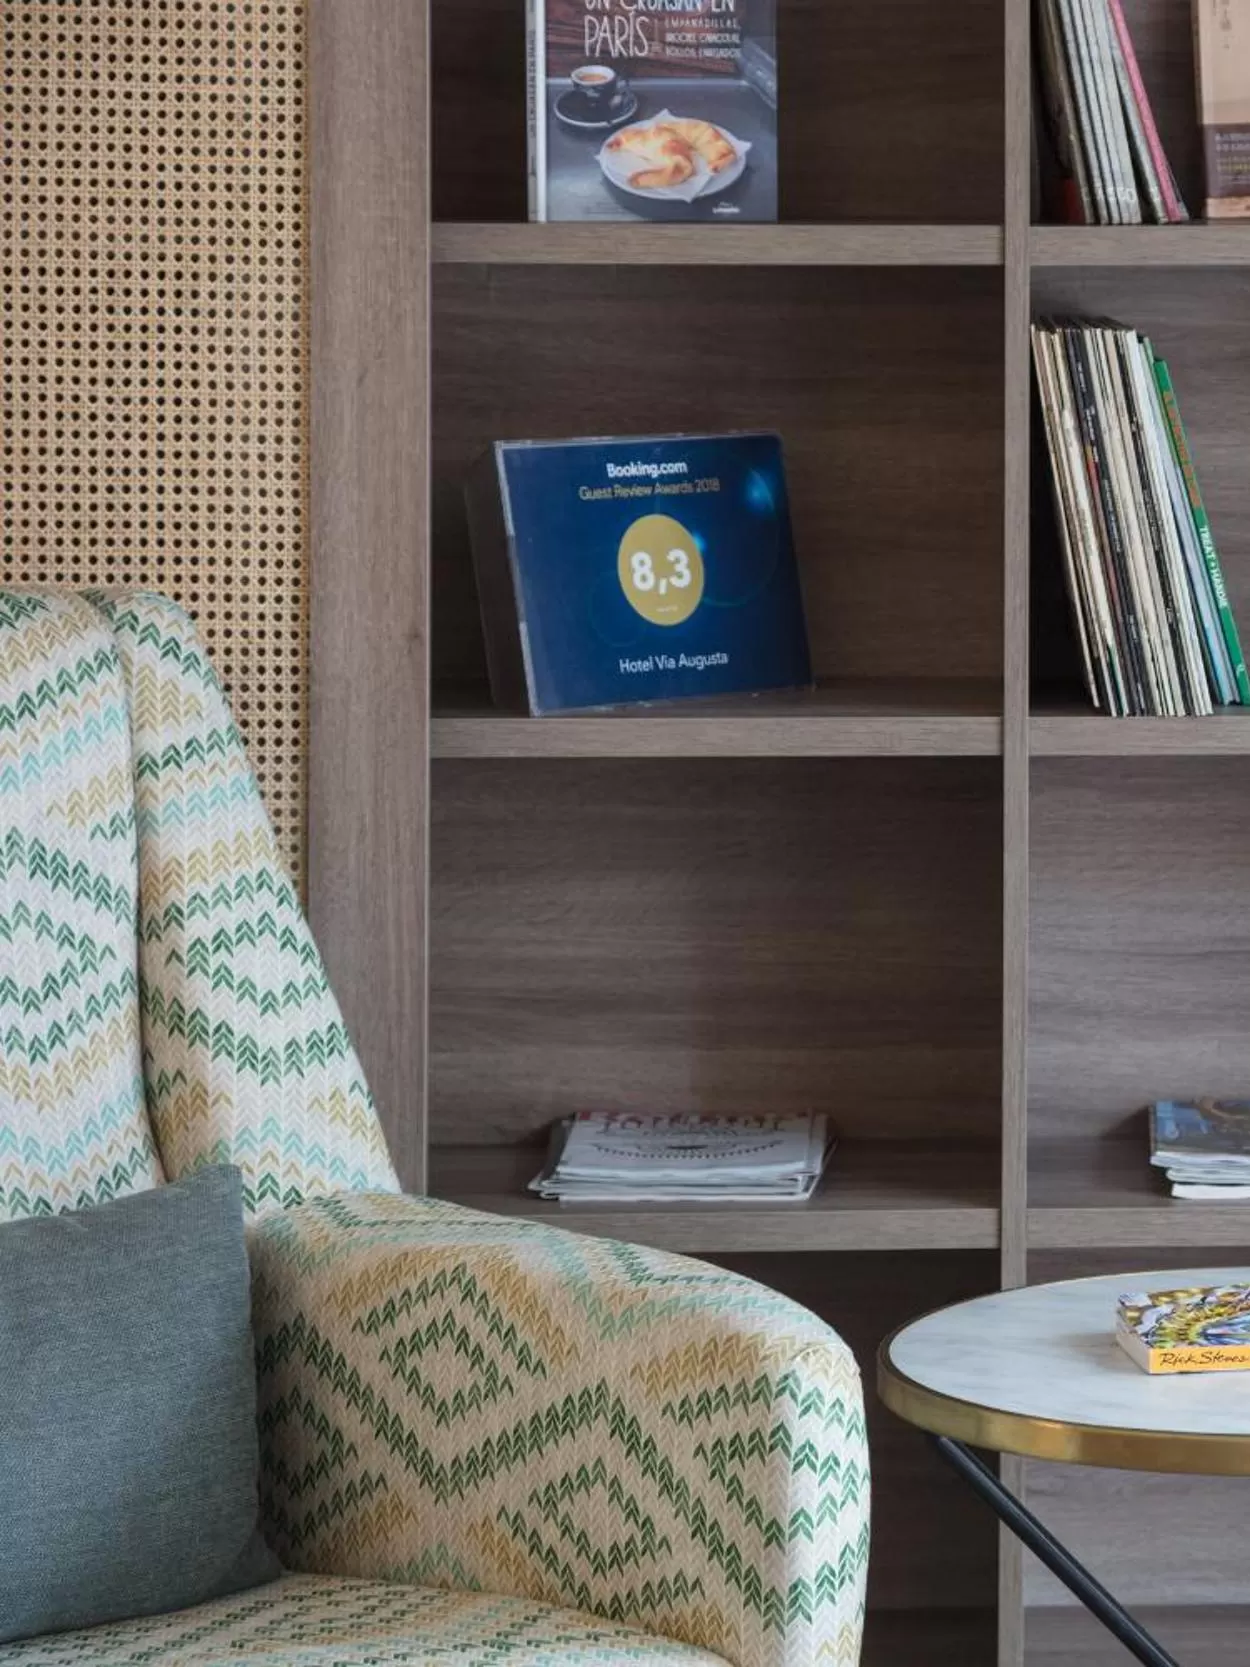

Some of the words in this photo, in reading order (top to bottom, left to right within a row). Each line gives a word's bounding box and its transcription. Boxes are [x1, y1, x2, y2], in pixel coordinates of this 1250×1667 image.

[584, 10, 649, 57] PARÍS
[606, 461, 688, 478] Booking.com
[579, 486, 613, 500] Guest
[614, 484, 653, 498] Review
[654, 481, 693, 495] Awards
[694, 478, 720, 492] 2018
[631, 549, 692, 595] 8,3
[619, 656, 654, 673] Hotel
[655, 654, 677, 670] Via
[678, 653, 729, 671] Augusta
[1159, 1352, 1197, 1366] Rick
